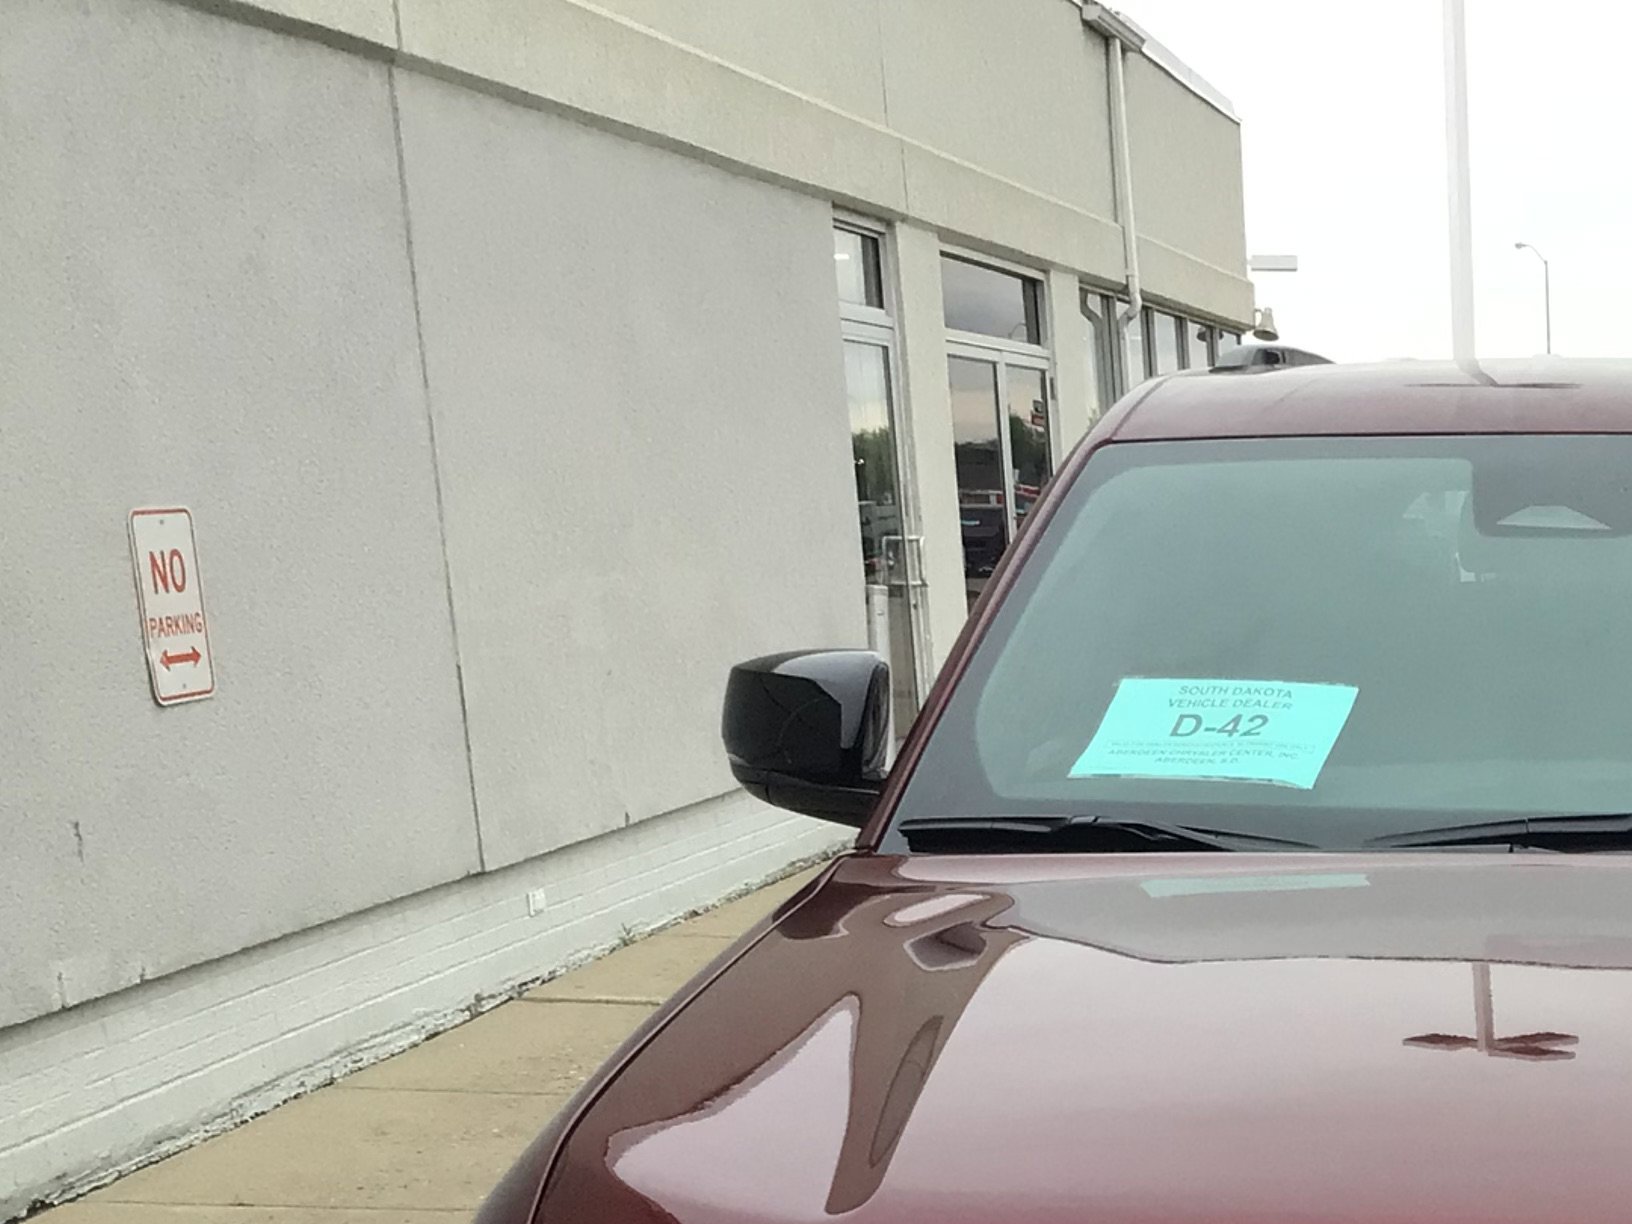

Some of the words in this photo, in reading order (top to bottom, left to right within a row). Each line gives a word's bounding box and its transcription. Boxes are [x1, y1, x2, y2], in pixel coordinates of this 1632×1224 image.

[149, 548, 186, 595] NO
[149, 612, 203, 639] PARKING
[1168, 698, 1227, 709] VEHICLE
[1232, 698, 1293, 710] DEALER
[1178, 685, 1229, 696] SOUTH
[1232, 686, 1293, 699] DAKOTA
[1169, 713, 1269, 737] D-42
